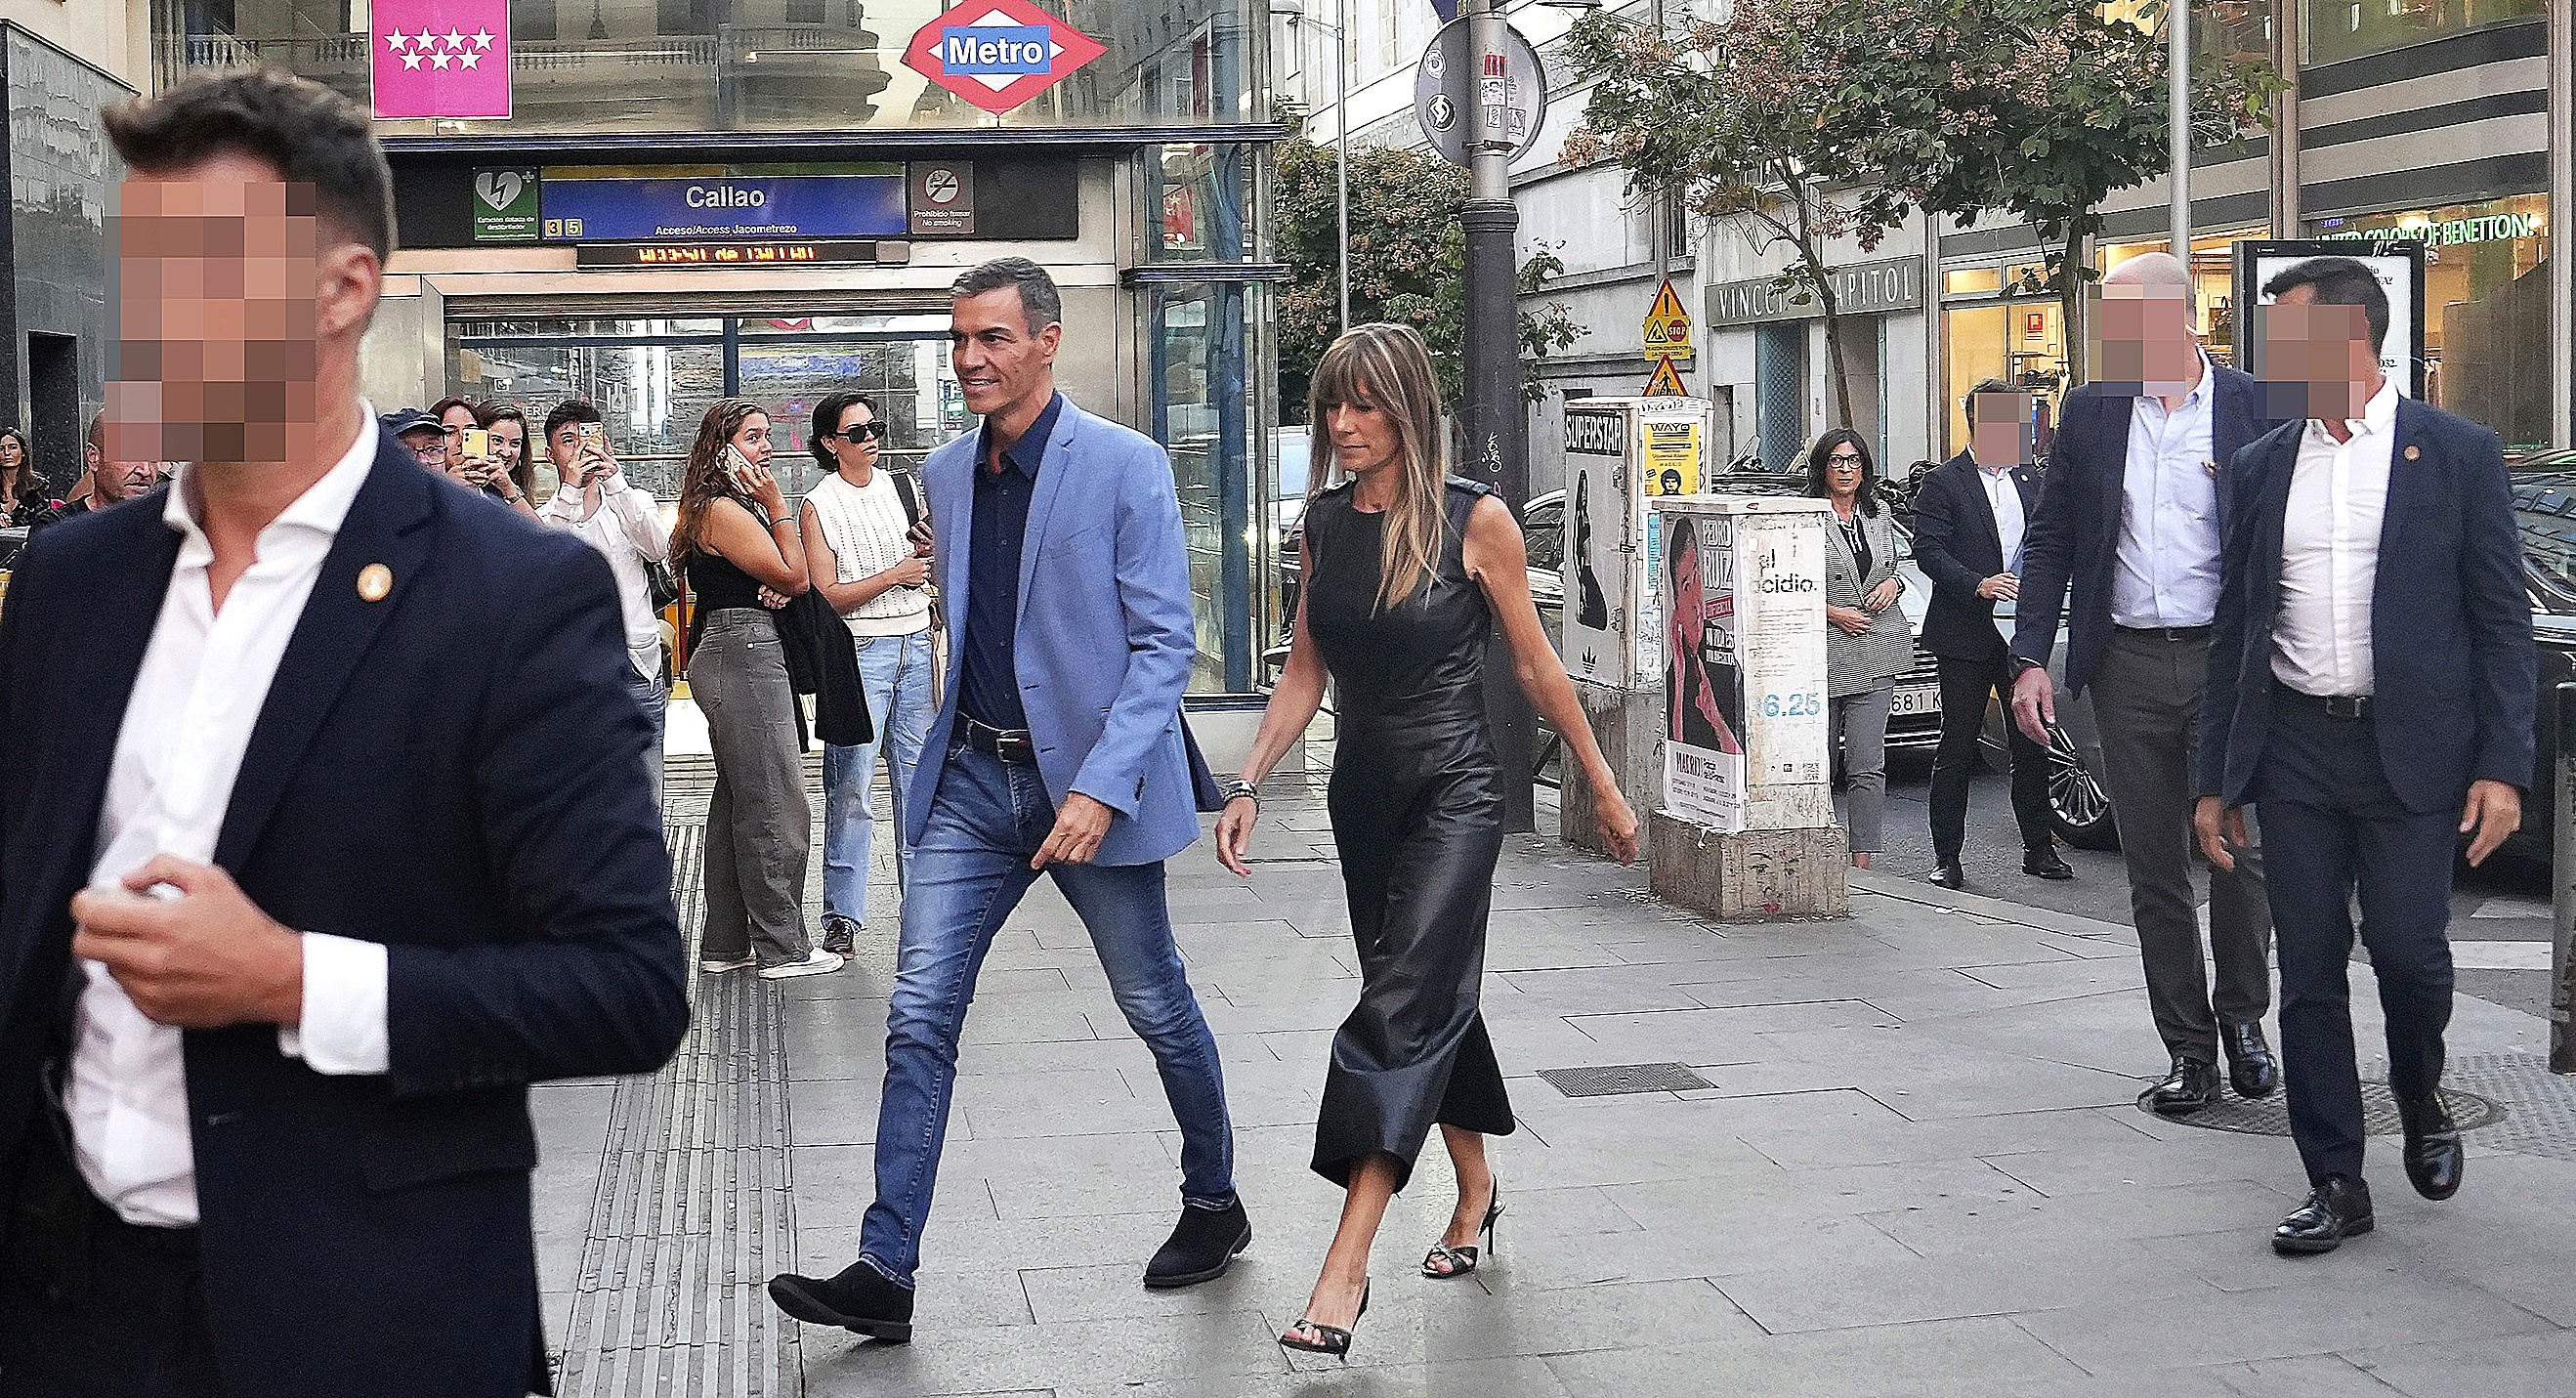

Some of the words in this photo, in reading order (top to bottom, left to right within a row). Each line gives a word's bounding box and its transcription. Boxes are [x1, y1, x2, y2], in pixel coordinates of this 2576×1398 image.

[948, 36, 1044, 64] Metro
[686, 186, 766, 208] Callao
[549, 221, 559, 233] 3
[569, 221, 579, 233] 5
[655, 225, 730, 235] Acceso/Access
[733, 225, 797, 233] Jacometrezo
[1834, 264, 1913, 309] APITOL
[1668, 326, 1685, 335] STOP
[1565, 414, 1622, 452] SUPERSTAR
[1703, 519, 1733, 547] PEDRO
[1704, 550, 1733, 590] RUIZ
[1763, 693, 1821, 716] 6.25
[1891, 693, 1923, 712] 681
